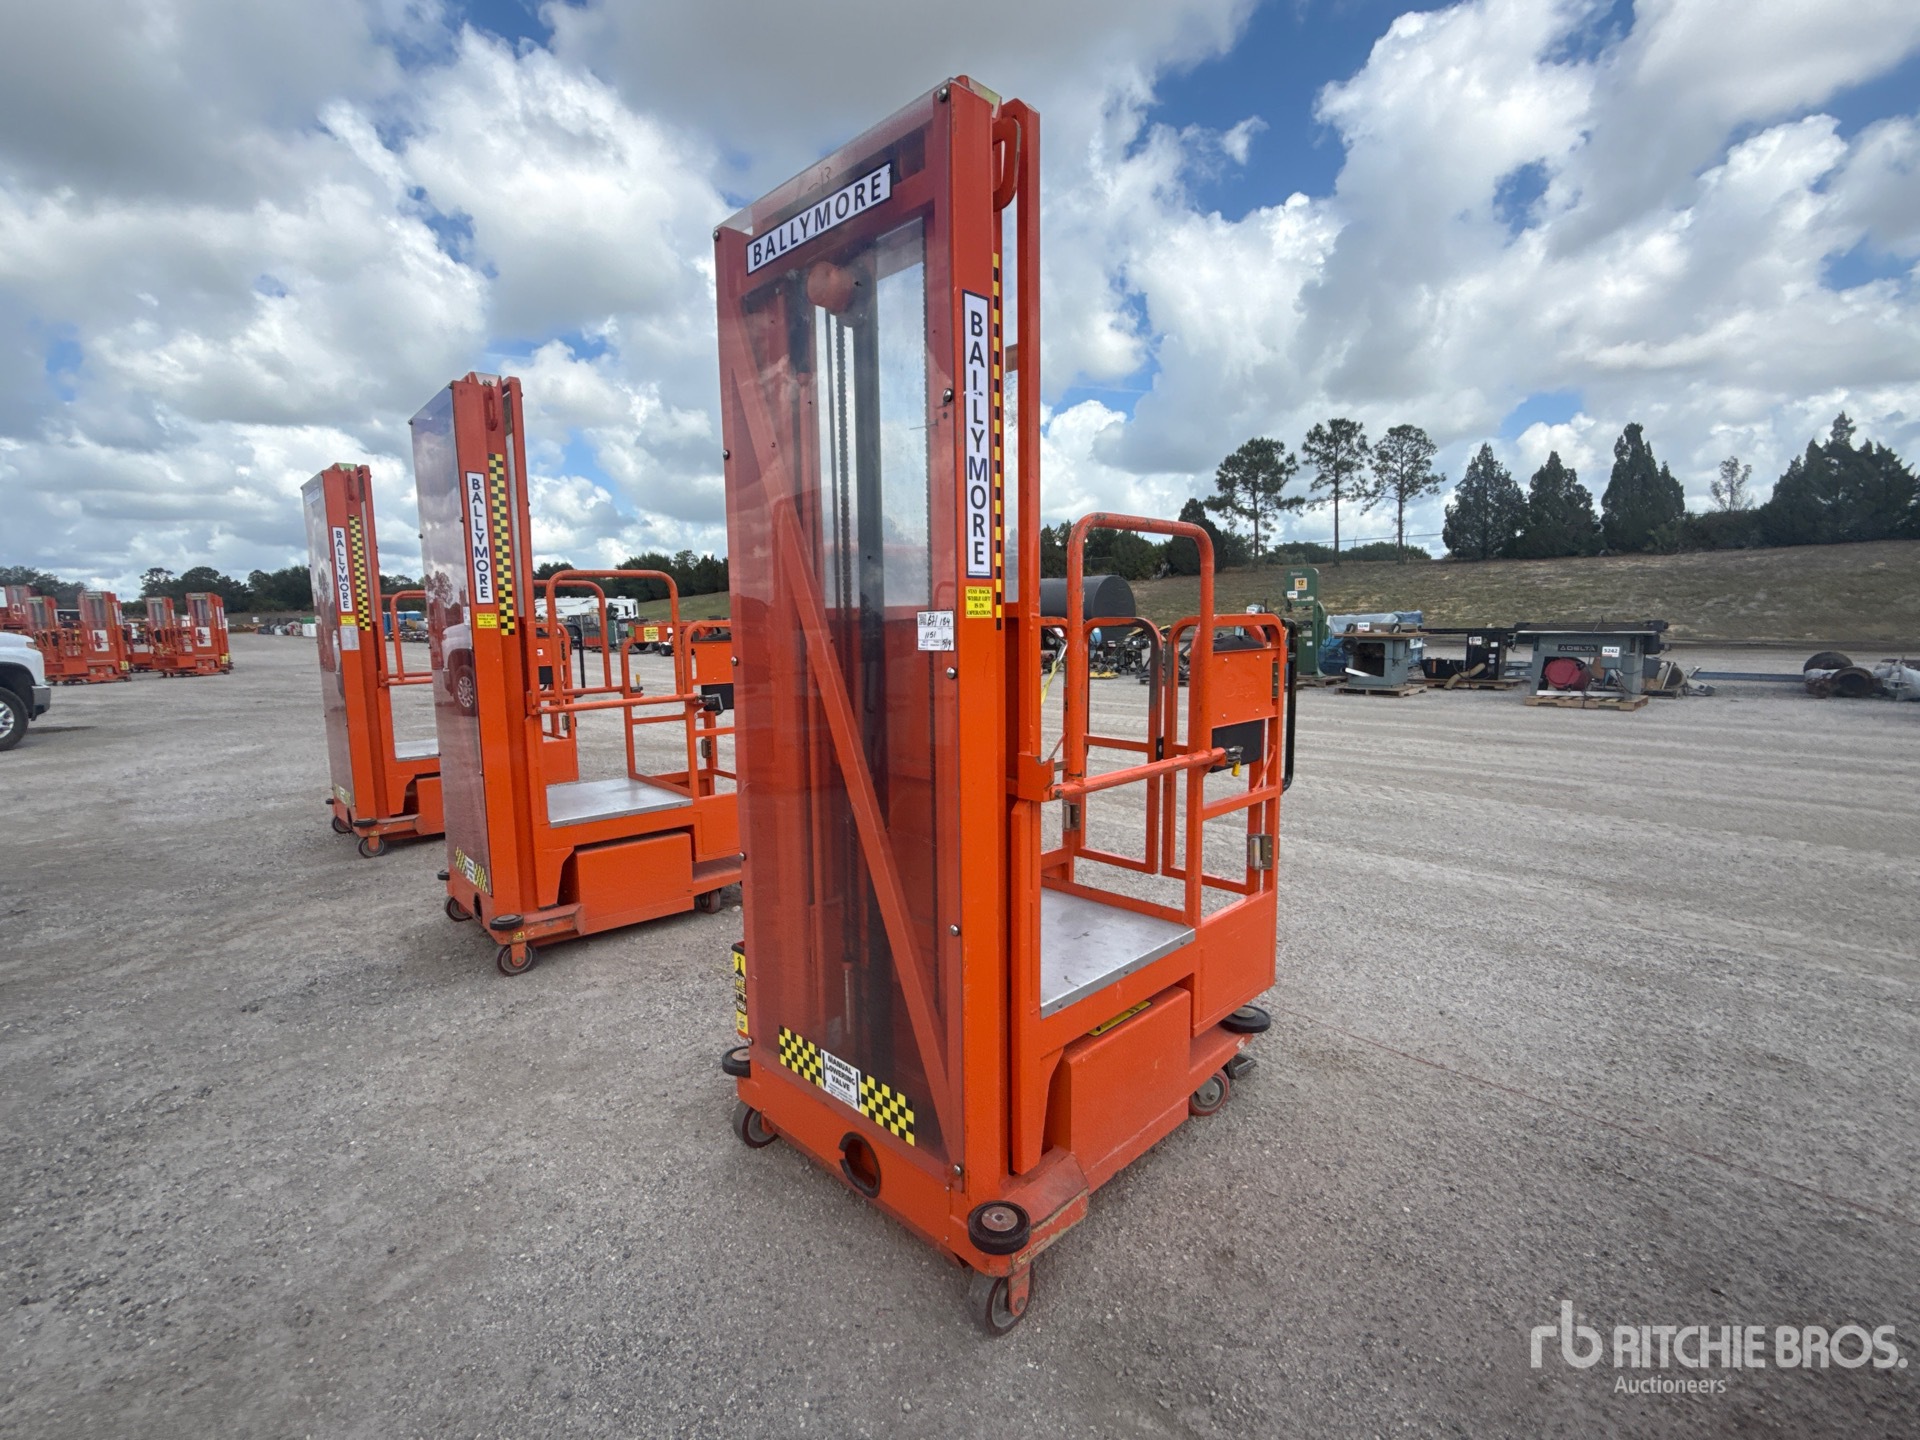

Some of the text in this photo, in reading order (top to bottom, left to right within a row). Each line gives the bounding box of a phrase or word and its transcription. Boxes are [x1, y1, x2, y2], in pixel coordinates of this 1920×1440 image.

[753, 173, 881, 266] BALLYMORE
[968, 310, 988, 566] BALLYMORE
[335, 530, 350, 609] BALLYMORE
[471, 478, 489, 599] BALLYMORE
[825, 1063, 856, 1086] LOWERING
[827, 1054, 853, 1076] MANUAL
[831, 1075, 851, 1092] VALVE
